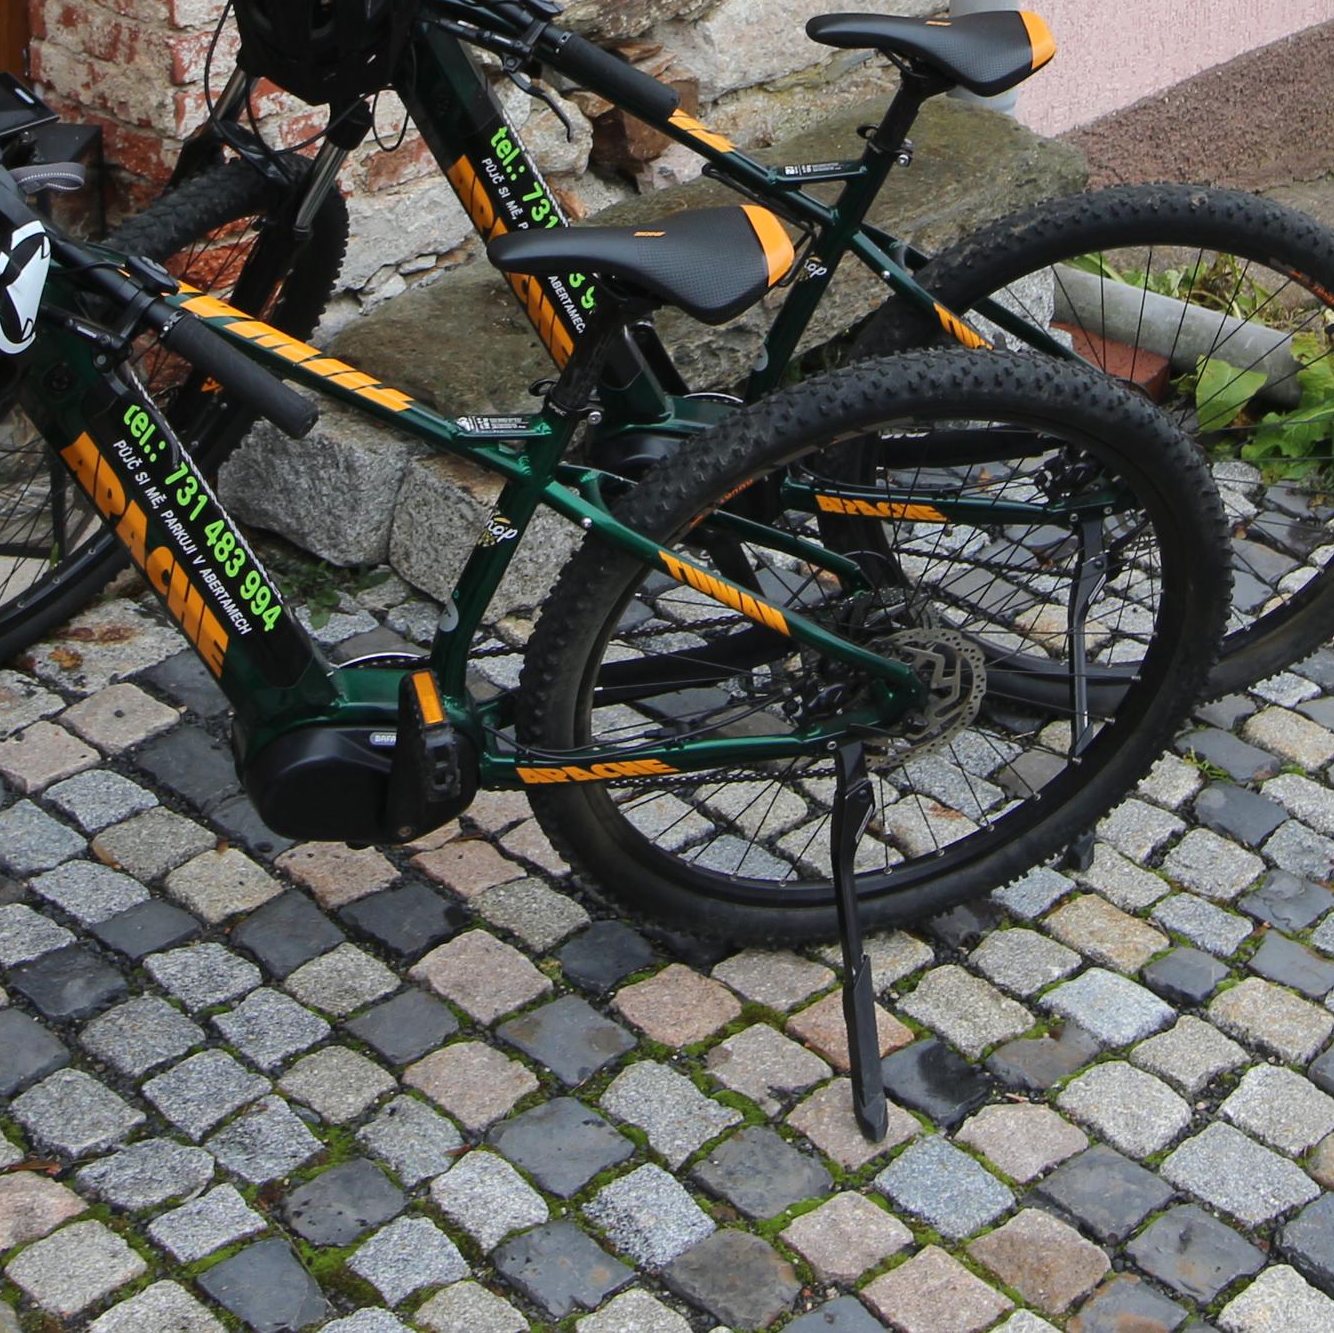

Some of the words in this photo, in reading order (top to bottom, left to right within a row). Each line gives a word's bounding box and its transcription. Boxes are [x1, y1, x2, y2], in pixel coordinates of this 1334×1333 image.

[490, 126, 525, 181] tel.:
[498, 186, 513, 199] SI
[548, 275, 586, 334] ABERTAMEC
[113, 440, 141, 470] PŮJČ
[134, 470, 151, 485] SI
[145, 486, 165, 510] MĚ,
[160, 510, 198, 557] PARKUJI
[165, 462, 208, 521] 731
[204, 520, 246, 578] 483
[240, 571, 282, 632] 994
[192, 554, 207, 566] V
[199, 568, 253, 636] ABERTAMECH
[515, 758, 680, 784] APACHE
